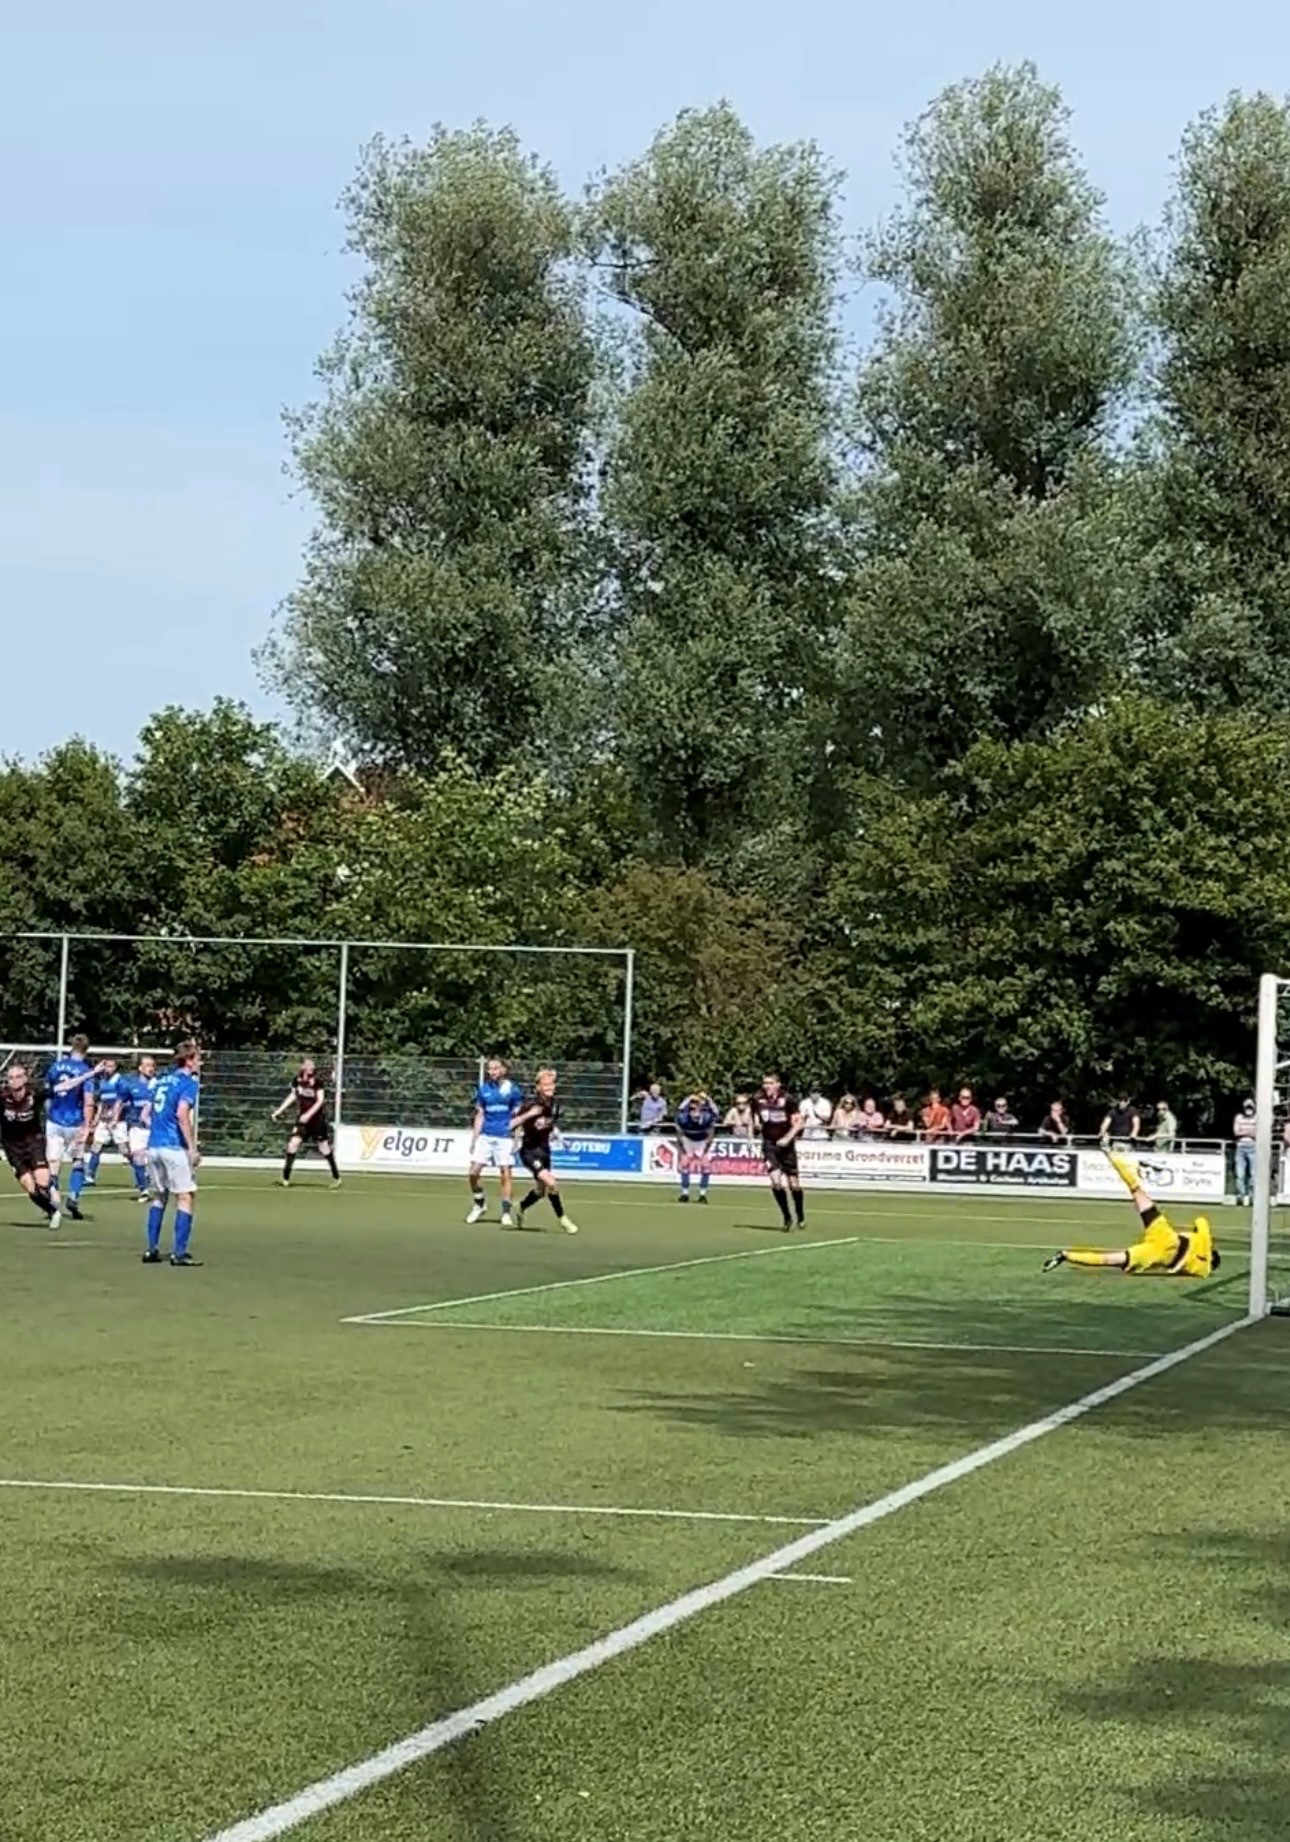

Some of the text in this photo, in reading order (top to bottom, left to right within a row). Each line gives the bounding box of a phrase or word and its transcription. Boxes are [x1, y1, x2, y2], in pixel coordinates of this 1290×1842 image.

[154, 1086, 169, 1113] 5
[361, 1127, 454, 1159] Yelgo IT
[936, 1151, 977, 1170] DE
[986, 1152, 1070, 1173] HAAS
